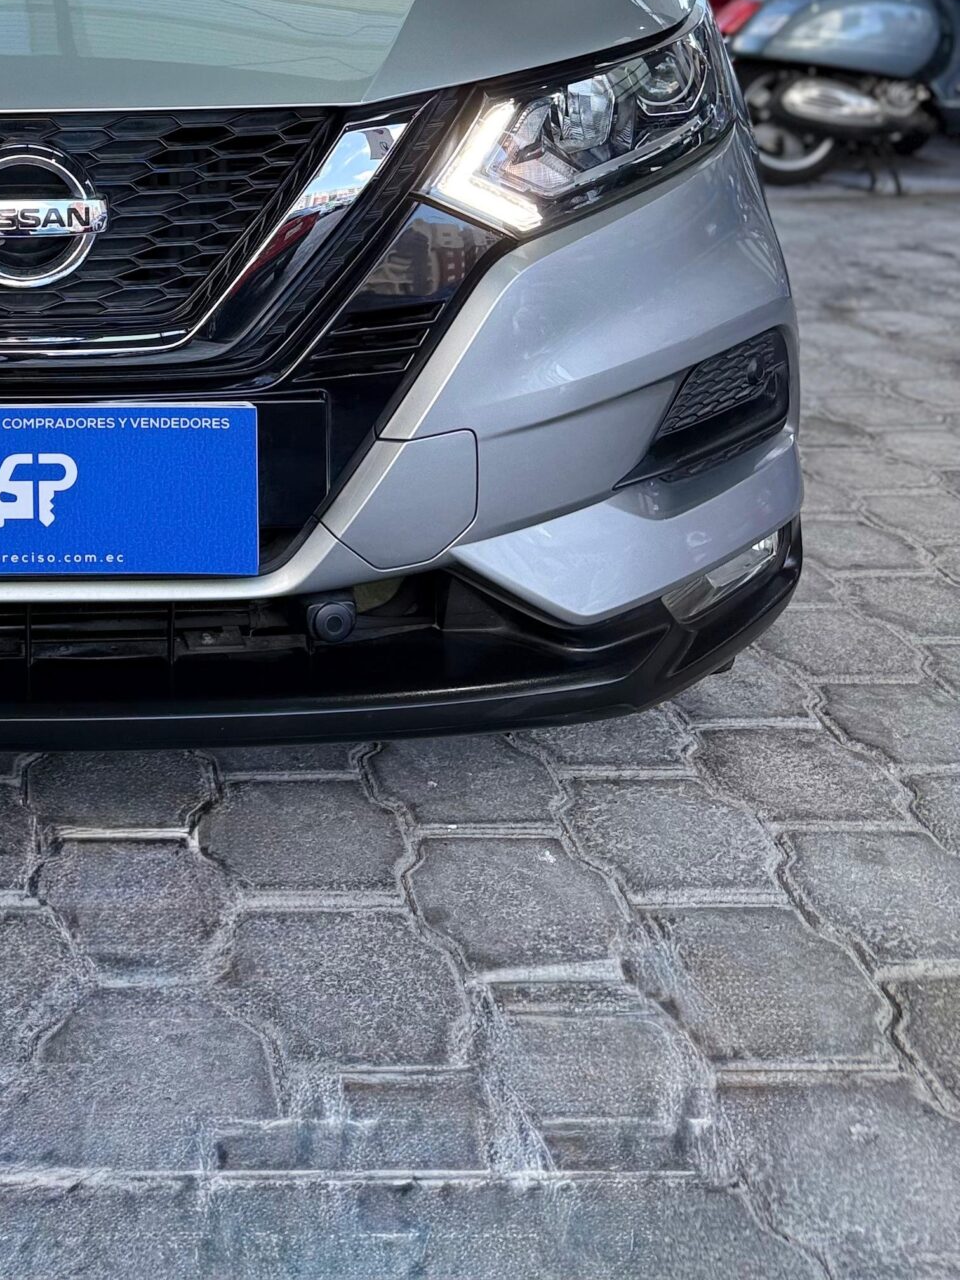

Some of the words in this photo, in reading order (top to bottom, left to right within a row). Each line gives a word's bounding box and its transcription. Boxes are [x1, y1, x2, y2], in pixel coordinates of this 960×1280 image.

[2, 417, 116, 430] COMPRADORES
[118, 417, 129, 429] Y
[130, 417, 231, 430] VENDEDORES
